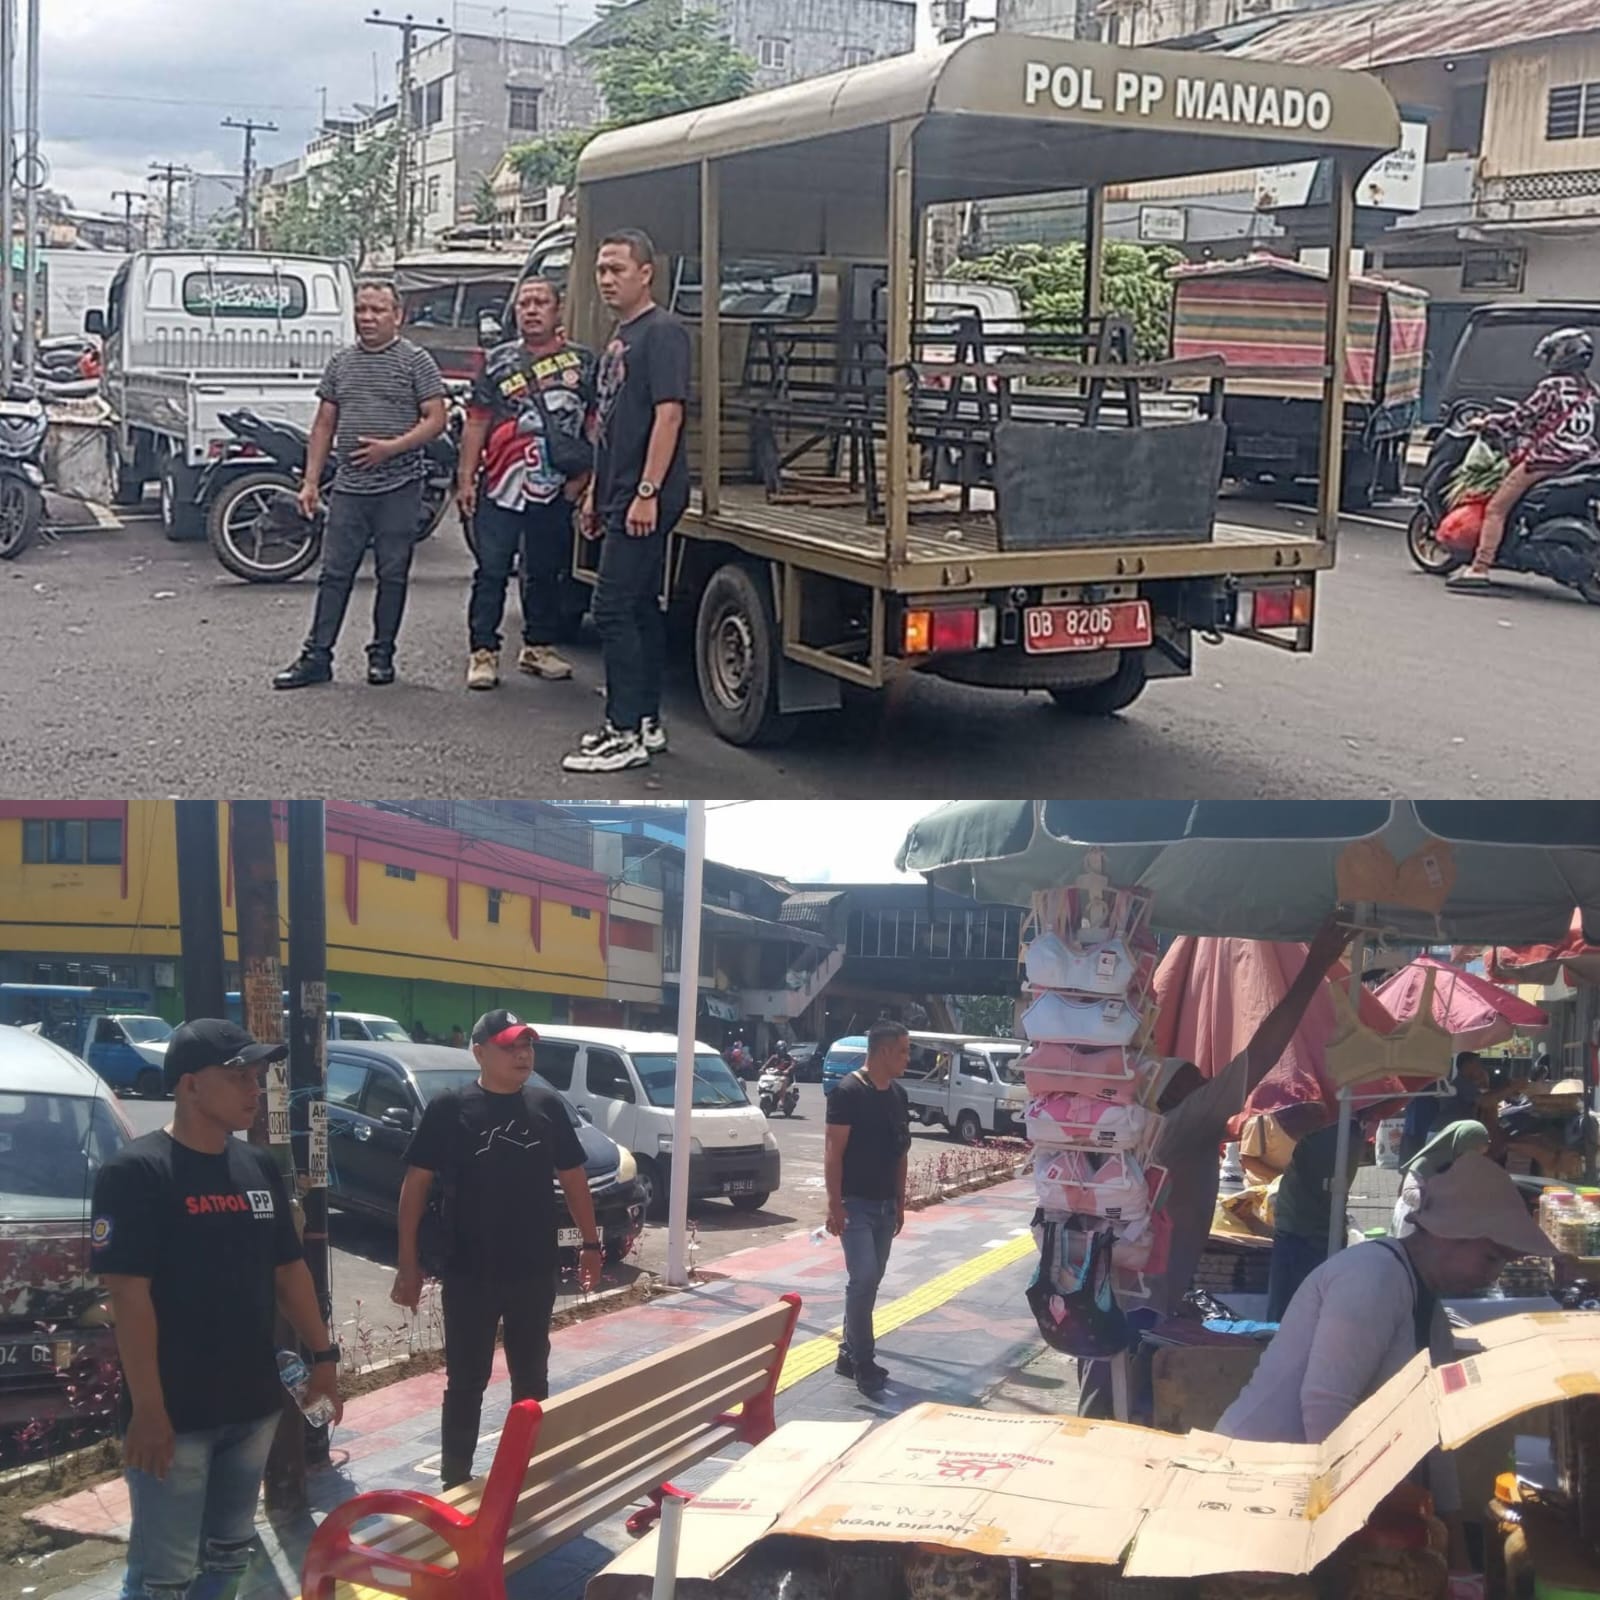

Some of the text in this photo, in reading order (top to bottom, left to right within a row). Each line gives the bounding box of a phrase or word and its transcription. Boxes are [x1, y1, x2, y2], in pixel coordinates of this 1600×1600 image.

[1025, 62, 1332, 131] POL PP MANADO
[1029, 605, 1147, 638] DB 8206 A
[184, 1192, 270, 1215] SATPOL PP
